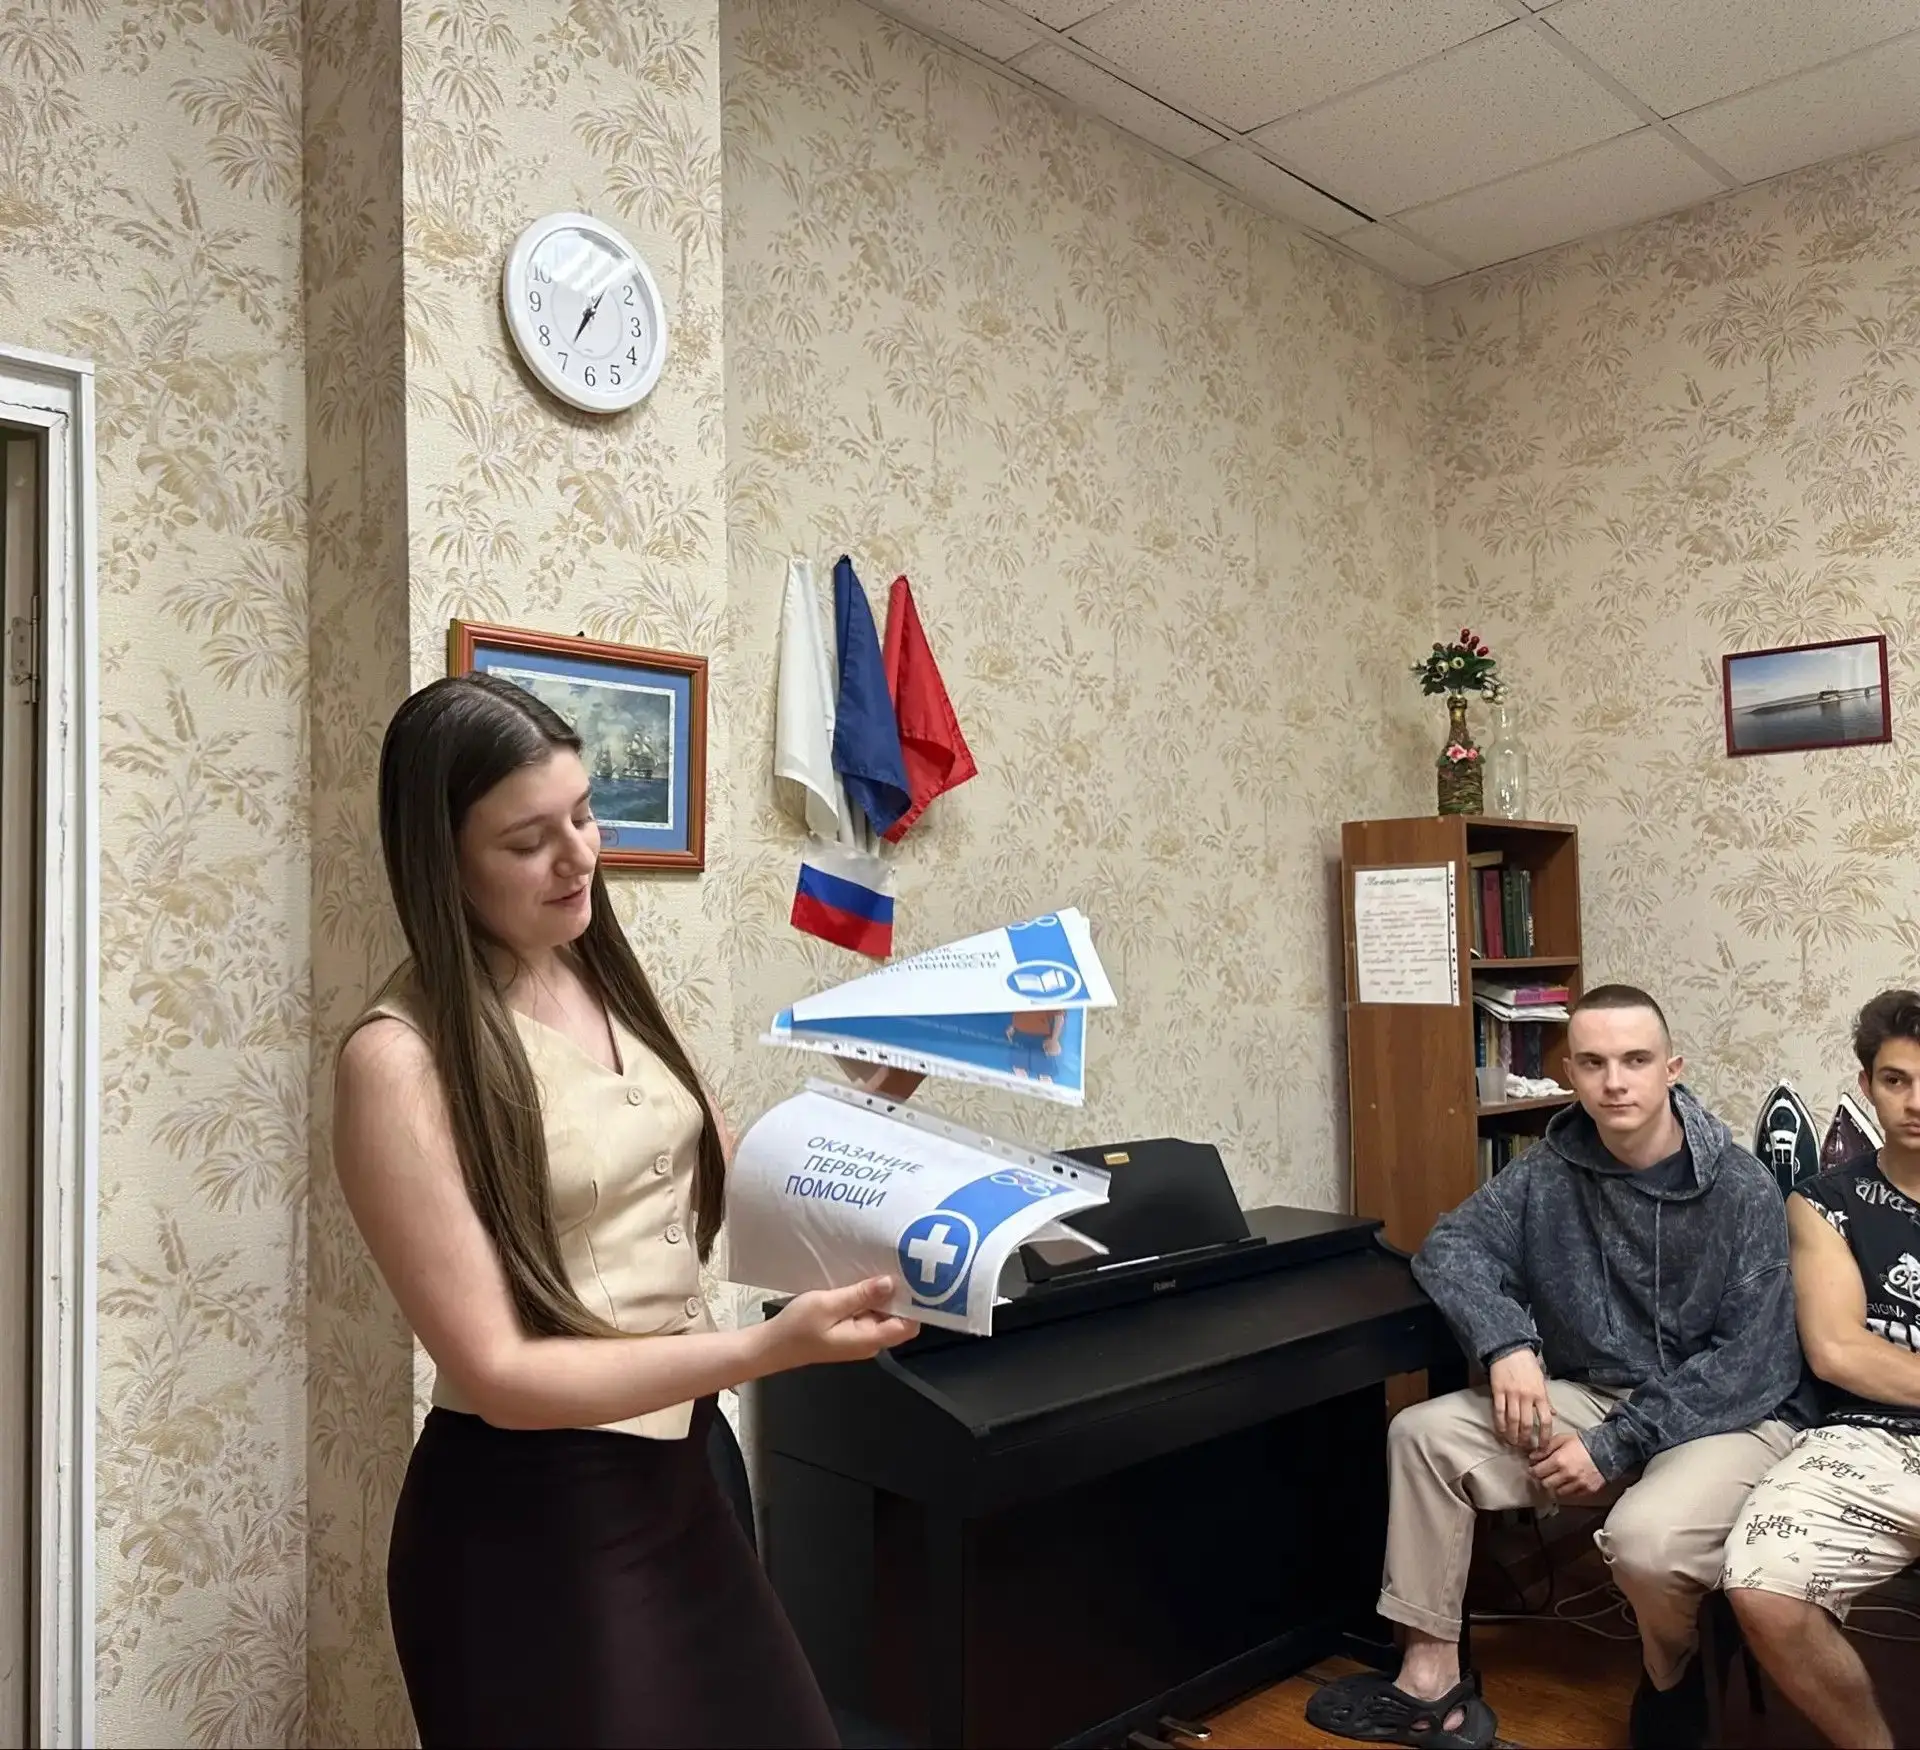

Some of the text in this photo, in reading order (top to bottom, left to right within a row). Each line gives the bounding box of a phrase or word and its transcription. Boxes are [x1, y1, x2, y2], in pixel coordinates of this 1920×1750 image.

[529, 291, 542, 312] 9
[622, 285, 635, 306] 2
[538, 325, 551, 347] 8
[630, 317, 642, 338] 3
[557, 352, 569, 373] 7
[626, 346, 638, 366] 4
[584, 366, 596, 387] 6
[610, 365, 621, 385] 5
[807, 1136, 924, 1174] ОКАЗАНИЕ
[804, 1154, 893, 1184] ПЕРВОЙ
[785, 1174, 888, 1210] ПОМОЩИ
[1745, 1521, 1808, 1536] NORTH
